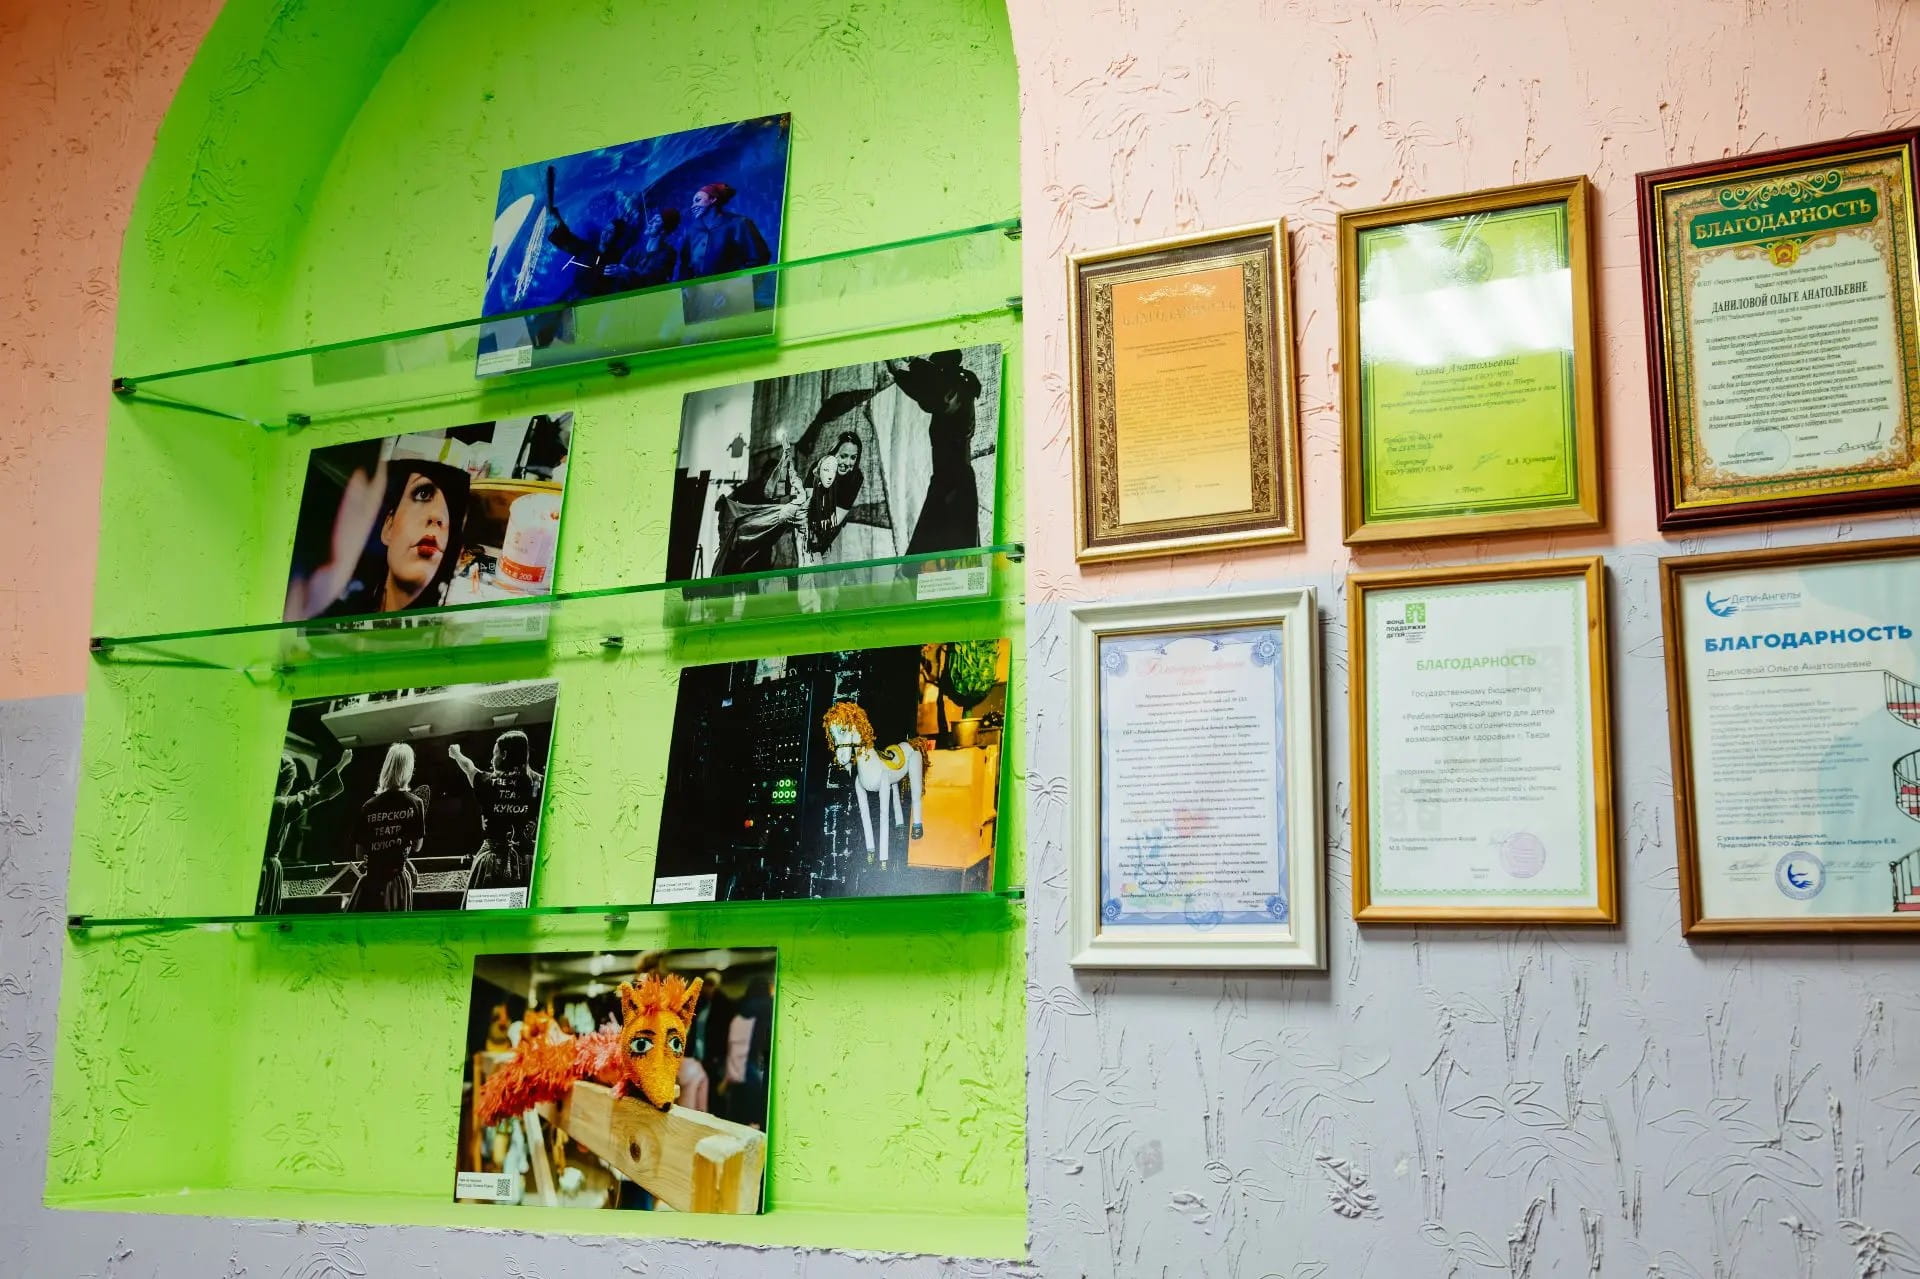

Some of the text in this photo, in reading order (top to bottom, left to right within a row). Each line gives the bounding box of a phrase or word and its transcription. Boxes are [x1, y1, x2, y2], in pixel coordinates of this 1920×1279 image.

[1695, 198, 1872, 240] БЛАГОДАРНОСТЬ
[1712, 293, 1768, 314] ДАНИЛОВОЙ
[1770, 290, 1799, 306] ОЛЬГЕ
[1802, 281, 1868, 302] АНАТОЛЬЕВНЕ
[1705, 625, 1913, 653] БЛАГОДАРНОСТЬ
[1416, 654, 1537, 671] БЛАГОДАРНОСТЬ
[1707, 665, 1765, 677] Даниловой
[1767, 663, 1800, 673] Ольге
[367, 807, 414, 823] ТВЕРСКОЙ
[493, 804, 529, 813] КУКОЛ
[375, 825, 402, 836] ТЕАТР
